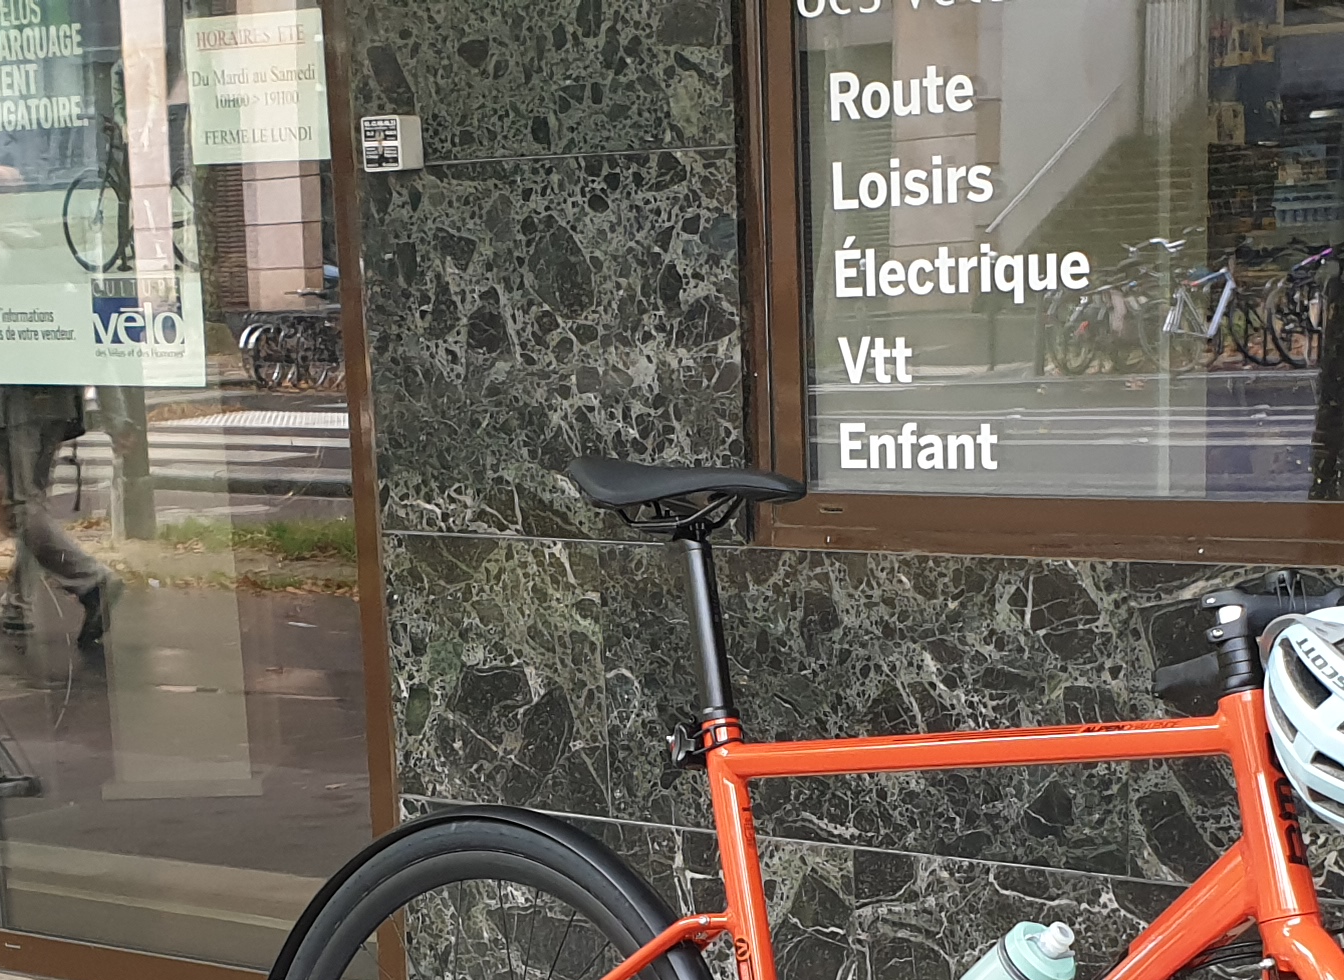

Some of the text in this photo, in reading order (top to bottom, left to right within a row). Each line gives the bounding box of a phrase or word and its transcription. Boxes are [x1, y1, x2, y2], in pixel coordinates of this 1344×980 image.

[196, 28, 271, 48] HORAIRES
[192, 63, 316, 87] Du Mardi au Samedi
[215, 93, 250, 109] 10H00
[264, 91, 299, 106] 19H00
[828, 65, 975, 122] Route
[204, 126, 312, 146] FERME LE LUNDI
[831, 155, 995, 211] Loisirs
[834, 237, 1091, 304] Électrique
[93, 279, 180, 297] CULTURE
[6, 326, 16, 340] de
[17, 327, 39, 340] votre
[41, 325, 76, 340] vendeur.
[837, 335, 913, 386] Vtt
[839, 421, 998, 471] Enfant
